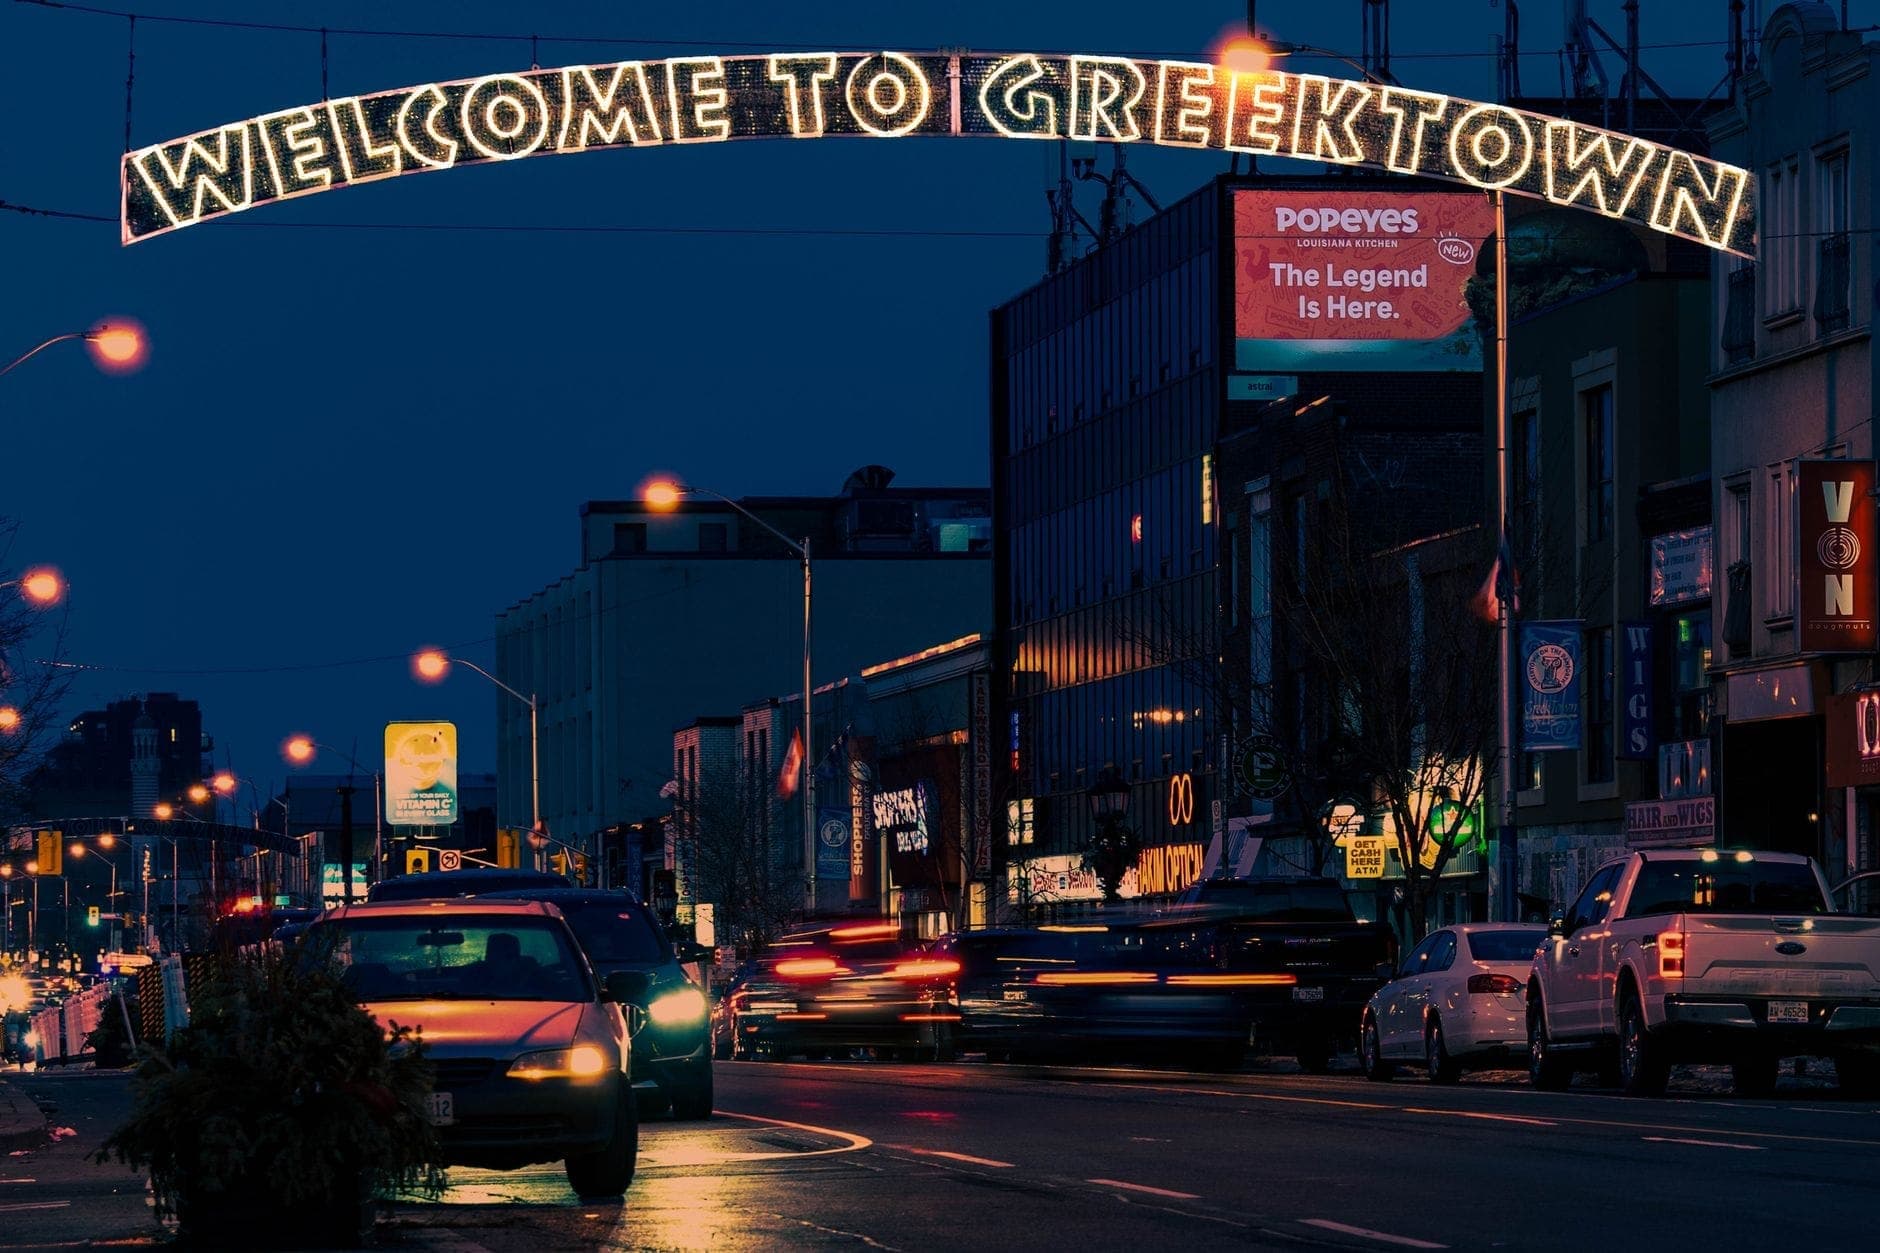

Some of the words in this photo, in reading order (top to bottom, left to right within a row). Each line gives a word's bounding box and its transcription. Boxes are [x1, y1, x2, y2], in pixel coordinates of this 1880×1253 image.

[132, 54, 731, 227] WELCOME
[768, 51, 932, 138] TO
[977, 52, 1751, 252] GREEKTOWN
[1297, 238, 1352, 248] LOUISIANA
[1355, 238, 1398, 248] KITCHEN
[1269, 262, 1320, 287] The
[1326, 263, 1428, 292] Legend
[1298, 295, 1321, 319] Is
[1327, 295, 1400, 319] Here.
[1247, 381, 1273, 391] astral
[1808, 622, 1871, 632] doughnuts
[1627, 626, 1650, 752] WIGS
[395, 799, 440, 810] VITAMIN
[1627, 806, 1662, 830] HAIR
[1663, 814, 1678, 827] AND
[1677, 801, 1713, 826] WIGS
[852, 783, 864, 876] SHOPPERS
[1354, 840, 1377, 849] GET
[1351, 849, 1381, 857] CASH
[1351, 858, 1381, 866] HERE
[1354, 867, 1378, 875] ATM
